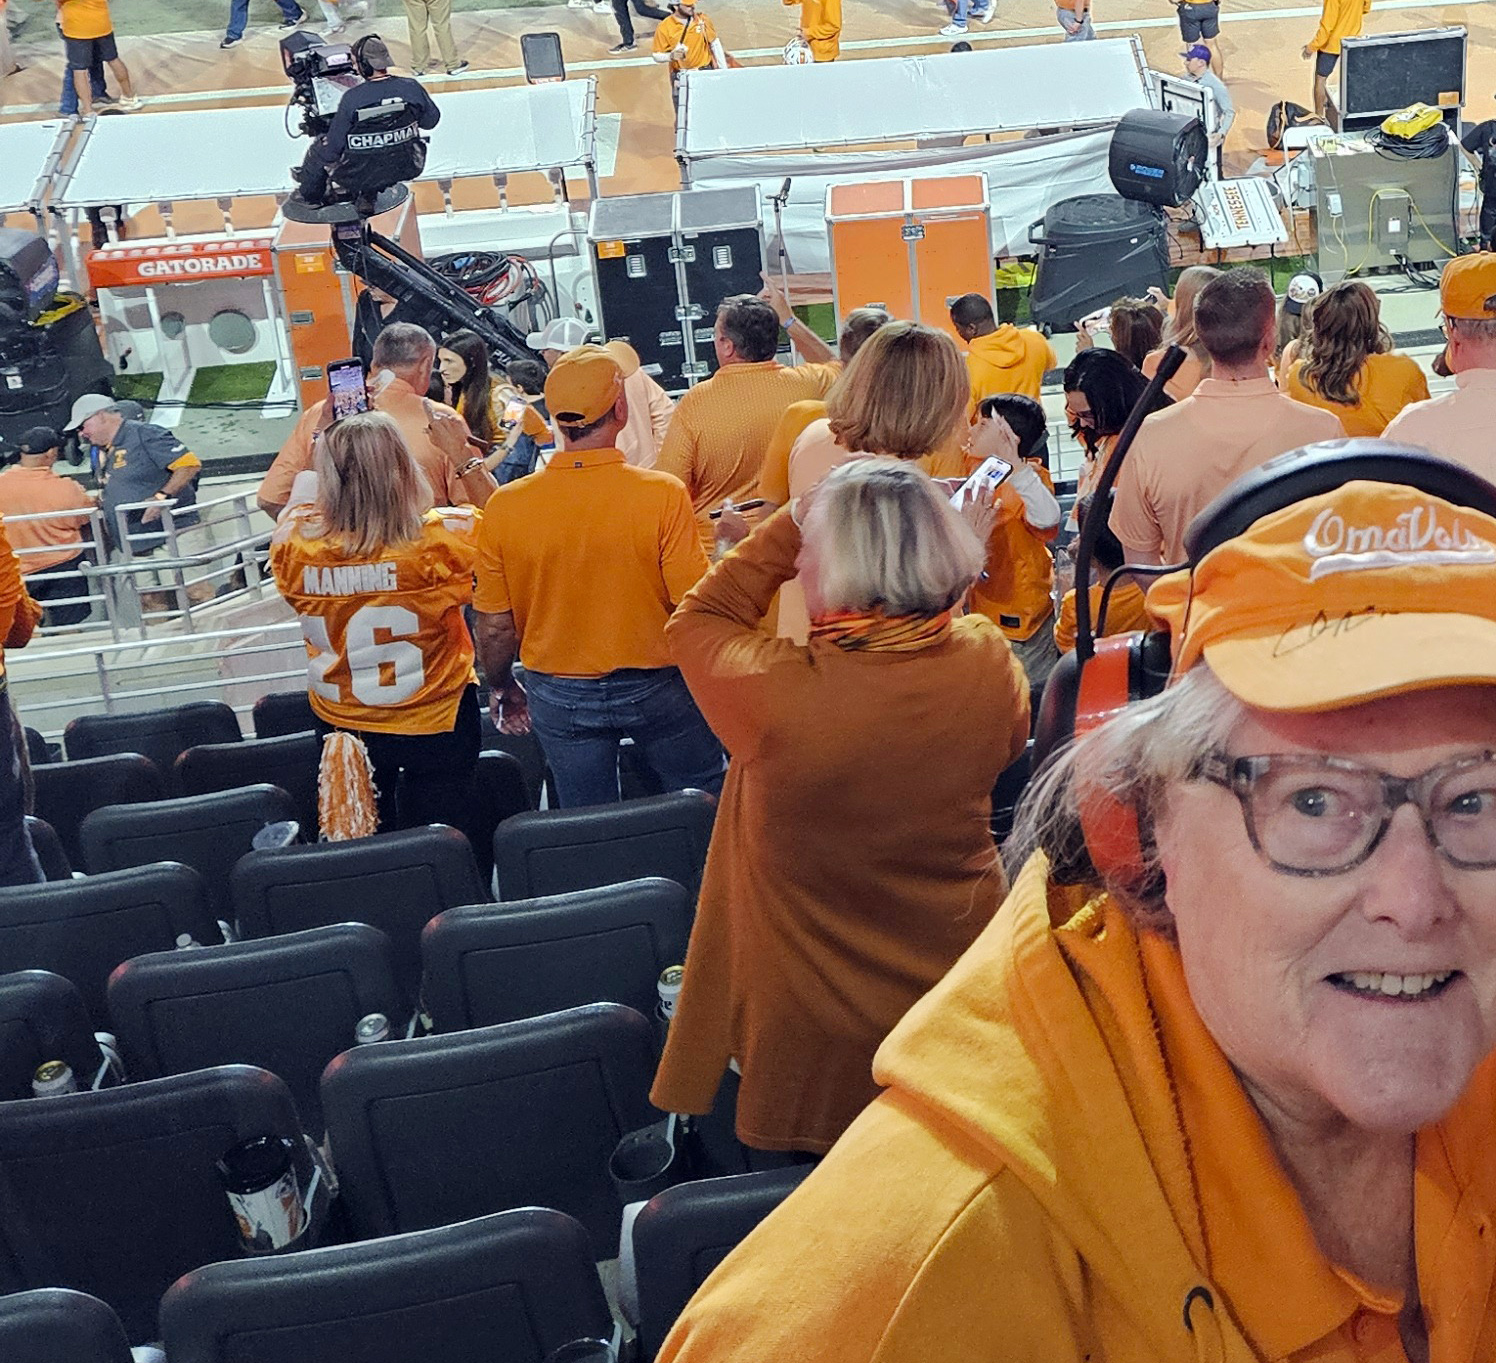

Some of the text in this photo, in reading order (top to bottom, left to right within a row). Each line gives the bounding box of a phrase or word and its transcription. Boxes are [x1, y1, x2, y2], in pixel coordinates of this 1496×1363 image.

[1222, 186, 1250, 230] TENNESSEE
[137, 253, 263, 277] GATORADE
[303, 563, 398, 596] MANNING
